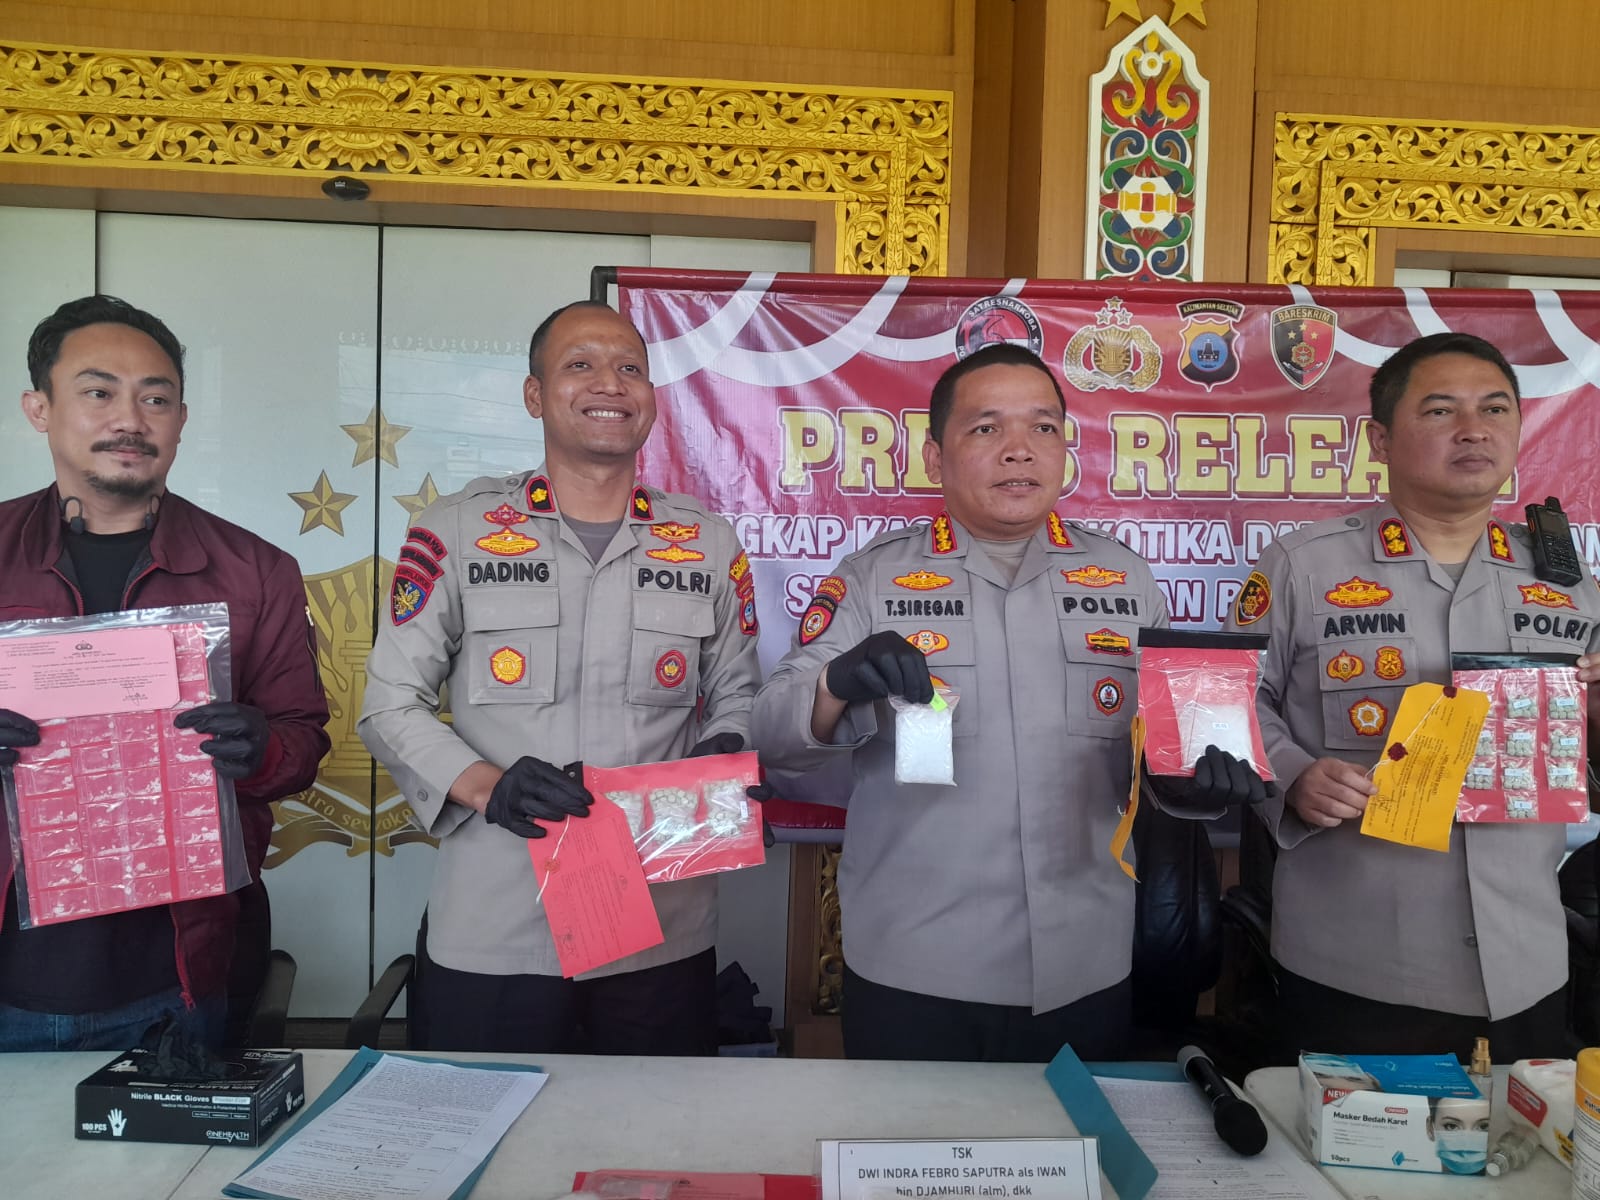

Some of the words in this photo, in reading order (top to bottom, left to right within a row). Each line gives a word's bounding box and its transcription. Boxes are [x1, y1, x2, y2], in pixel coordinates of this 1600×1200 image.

[968, 299, 1037, 331] SATRESNARKOBA
[1277, 308, 1331, 322] BARESKRIM
[778, 408, 1082, 498] PRE
[1109, 412, 1519, 503] RELEA
[468, 562, 550, 585] DADING
[638, 568, 711, 595] POLRI
[885, 599, 964, 616] T.SIREGAR
[1063, 597, 1138, 616] POLRI
[1324, 613, 1406, 638] ARWIN
[1514, 613, 1588, 641] POLRI
[131, 1092, 152, 1100] Nitrile
[154, 1093, 182, 1101] BLACK
[184, 1094, 210, 1103] Gloves
[1333, 1111, 1361, 1121] Masker
[1363, 1115, 1386, 1124] Bedah
[1387, 1118, 1408, 1126] Karet
[94, 1123, 107, 1132] PCS
[952, 1147, 973, 1159] TSK
[858, 1168, 880, 1179] DWI
[883, 1168, 918, 1178] INDRA
[922, 1167, 959, 1178] FEBRO
[963, 1167, 1015, 1178] SAPUTRA
[1018, 1167, 1034, 1177] als
[1037, 1166, 1066, 1177] IWAN
[978, 1184, 1010, 1197] (alm),
[1013, 1184, 1032, 1196] dkk
